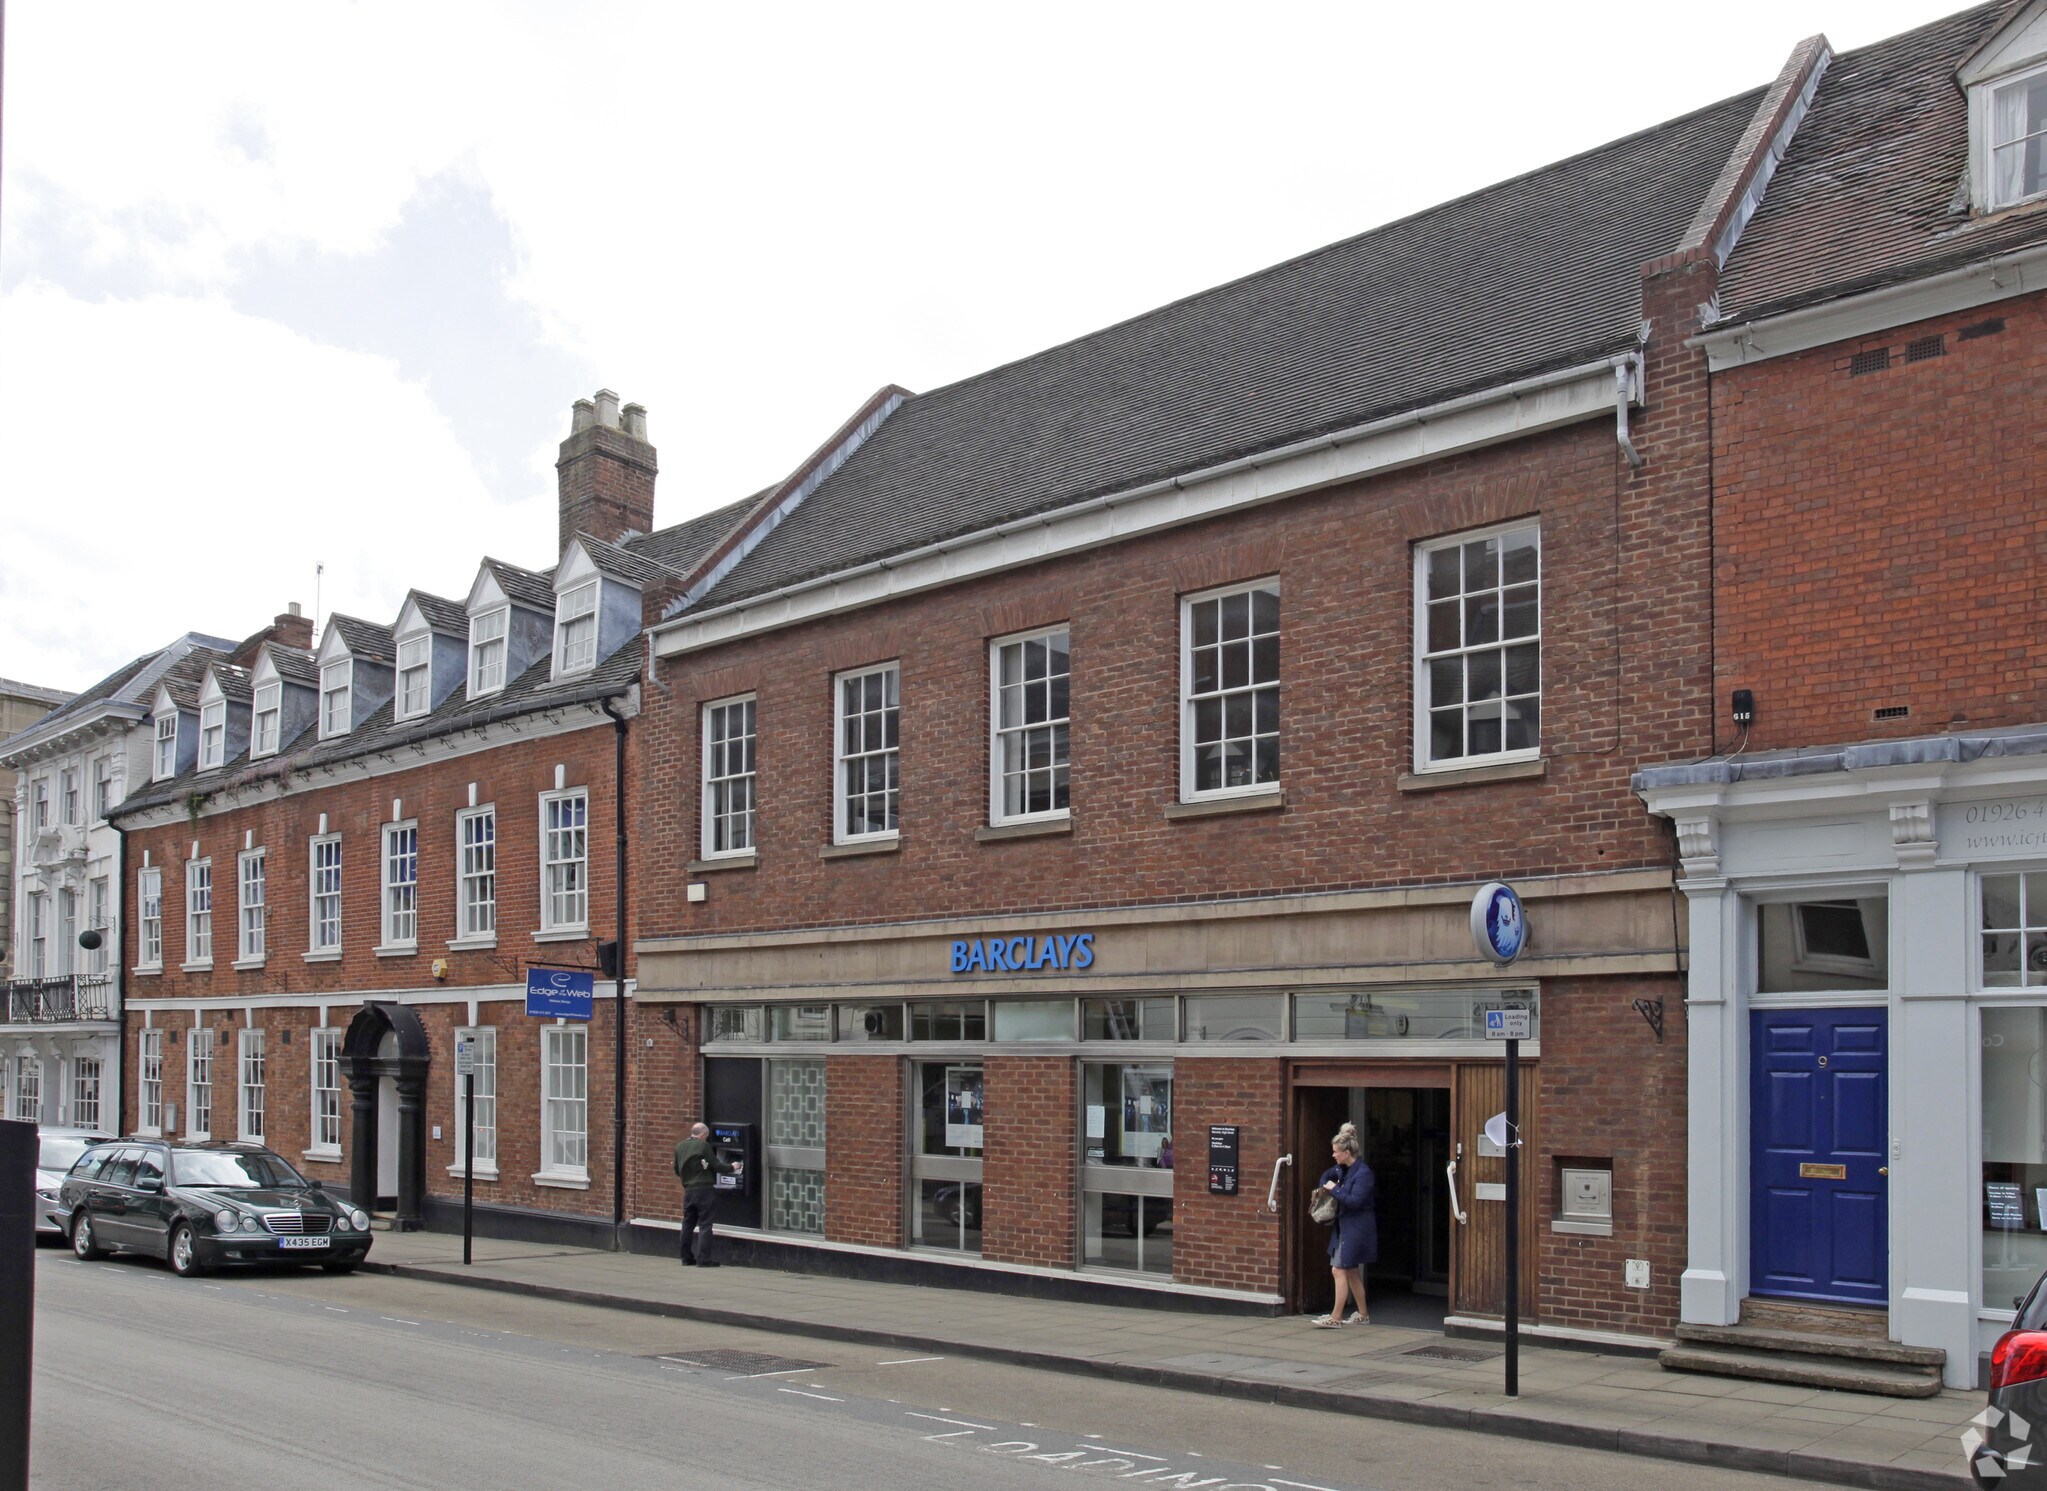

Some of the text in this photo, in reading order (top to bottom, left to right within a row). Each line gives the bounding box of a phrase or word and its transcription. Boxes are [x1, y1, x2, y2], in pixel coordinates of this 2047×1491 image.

[1966, 799, 2044, 824] 01926 4
[951, 933, 1095, 973] BARCLAYS
[530, 986, 558, 996] Edge
[567, 989, 591, 998] Web
[1818, 1056, 1827, 1068] 9
[286, 1238, 310, 1246] X435
[920, 1431, 1277, 1491] LOADIN
